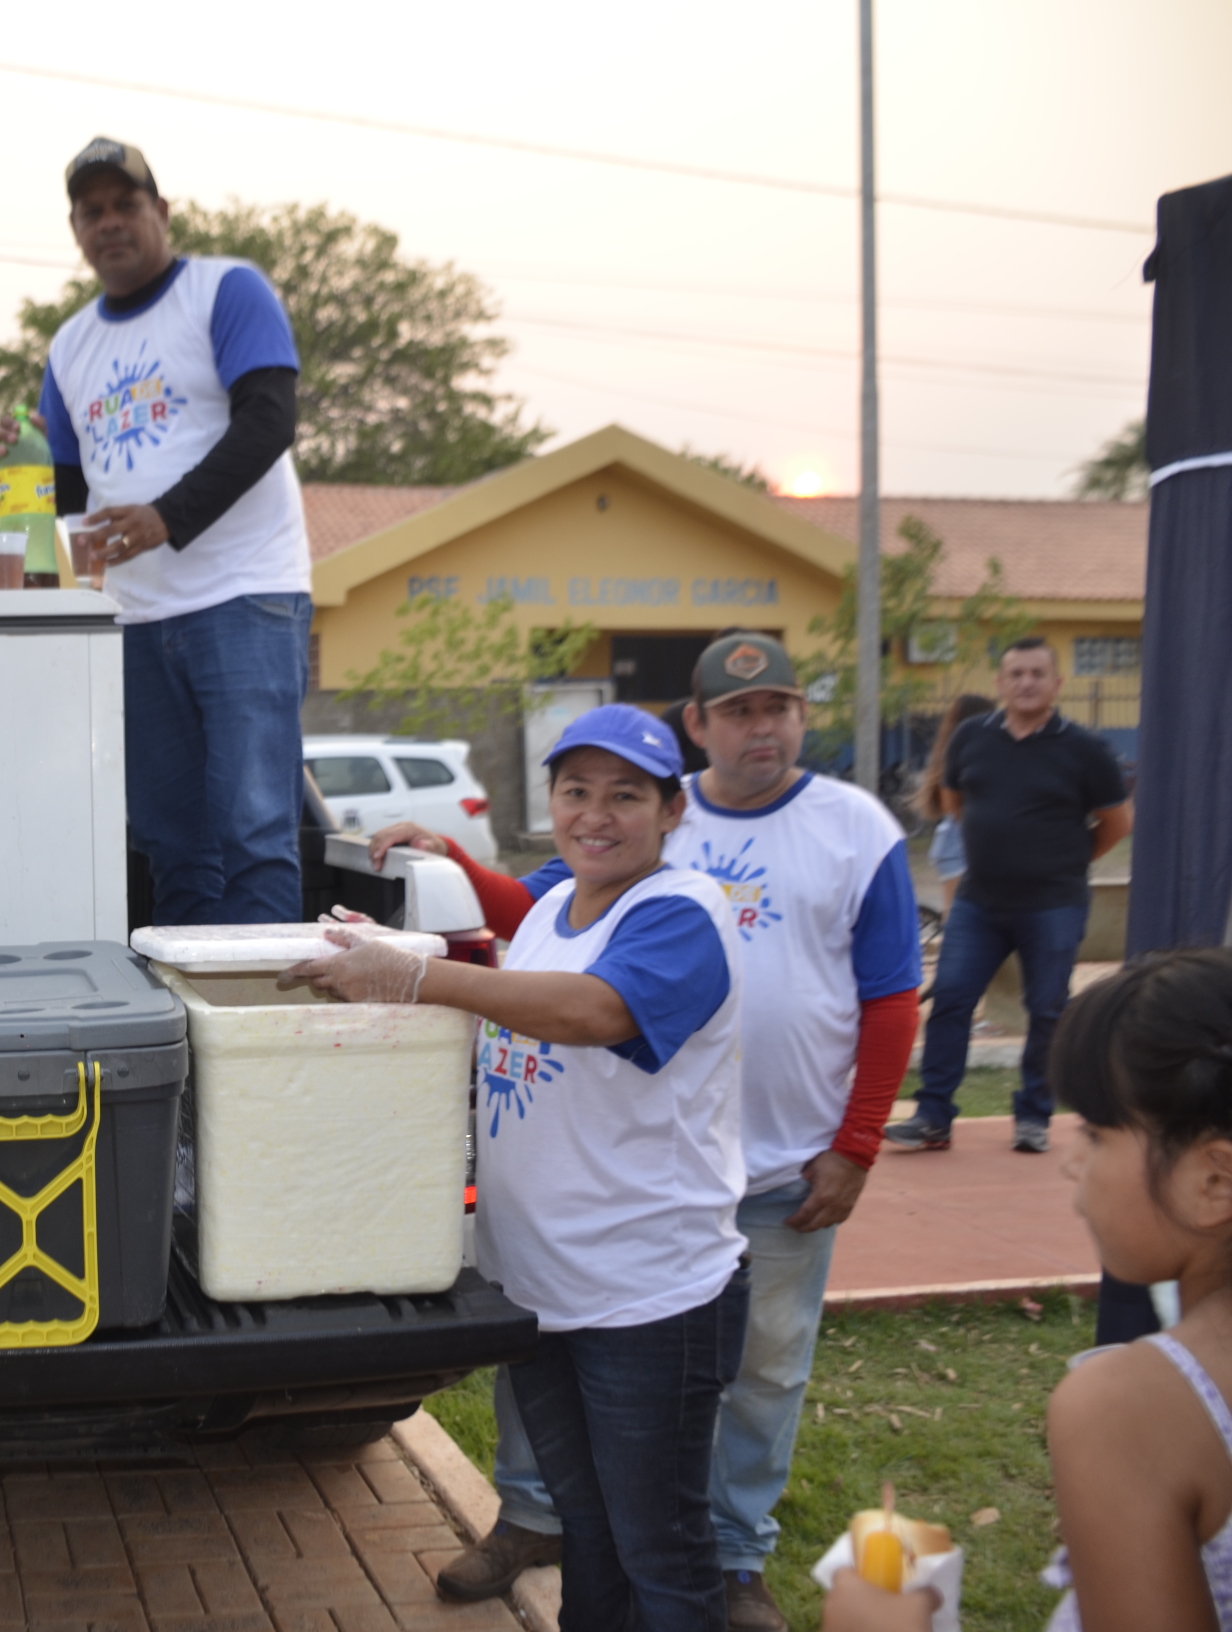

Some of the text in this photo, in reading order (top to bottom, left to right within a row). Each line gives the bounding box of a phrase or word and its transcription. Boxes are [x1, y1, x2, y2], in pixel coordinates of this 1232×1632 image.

[89, 388, 132, 424] RUA
[90, 401, 167, 443] LAZER
[477, 1042, 536, 1084] AZER
